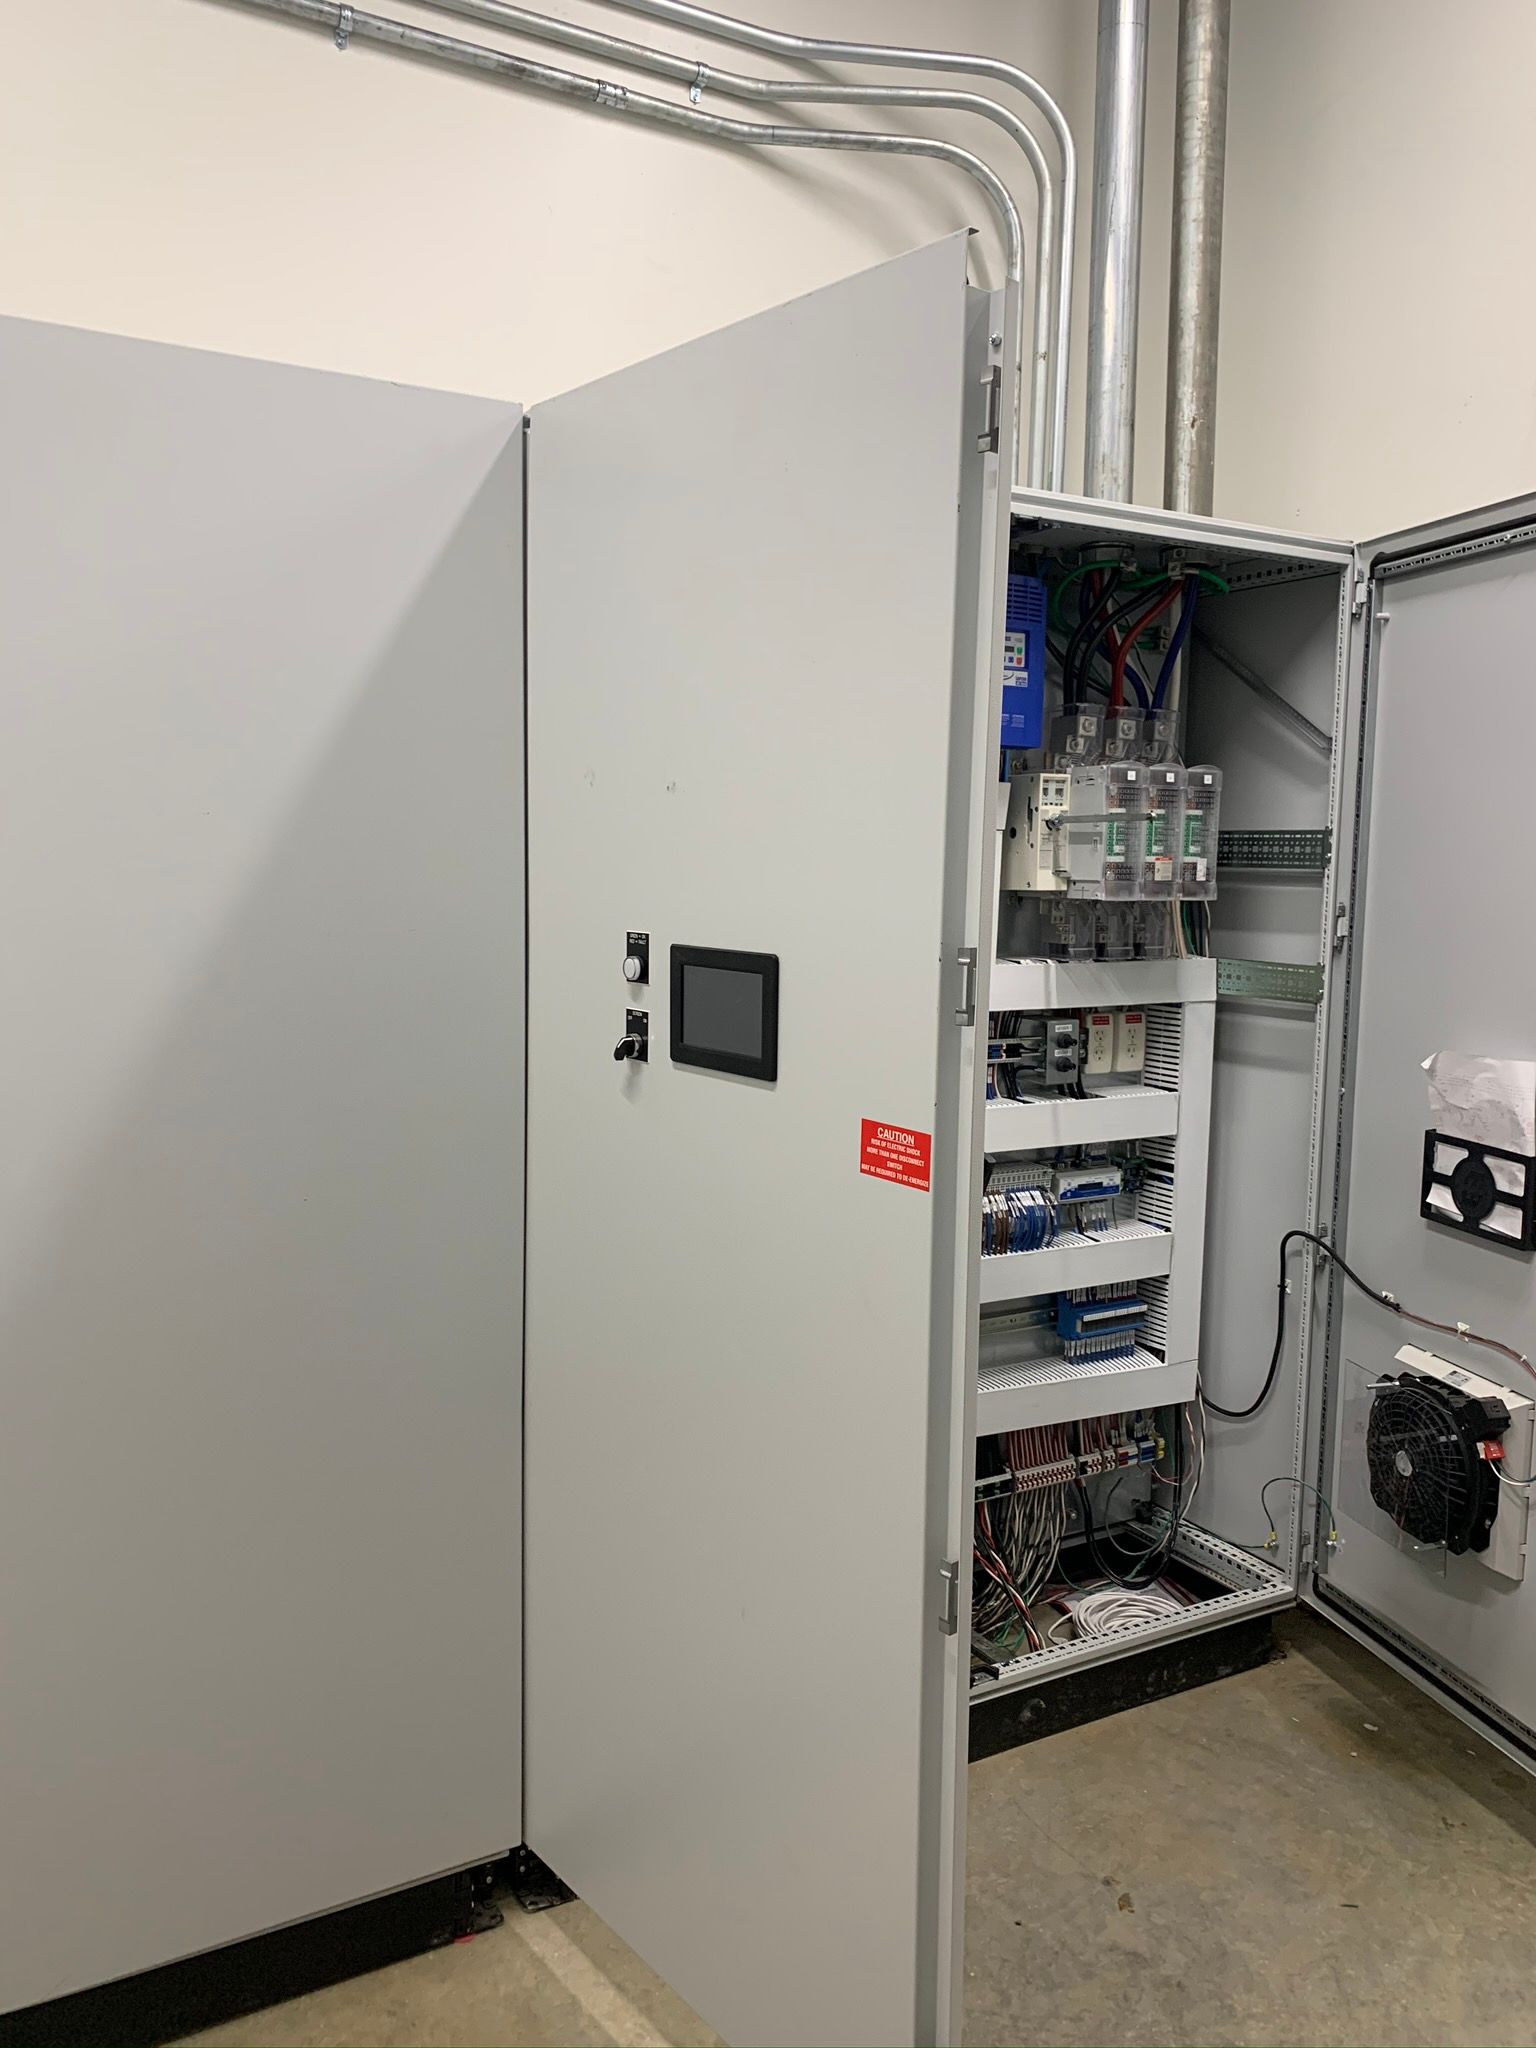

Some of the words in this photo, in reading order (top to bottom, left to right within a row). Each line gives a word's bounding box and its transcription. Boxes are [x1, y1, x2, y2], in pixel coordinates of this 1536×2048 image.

[877, 1127, 915, 1145] CAUTION
[866, 1146, 878, 1155] MORE
[879, 1149, 889, 1158] THAN
[890, 1152, 899, 1161] ONE
[899, 1155, 925, 1167] DISCONNECT
[871, 1138, 881, 1147] RISK
[881, 1140, 887, 1148] OF
[887, 1142, 906, 1153] ELECTRIC
[906, 1147, 921, 1157] SHOCK
[876, 1167, 896, 1178] REQUIRED
[897, 1173, 903, 1181] TO
[886, 1161, 903, 1170] SWITCH
